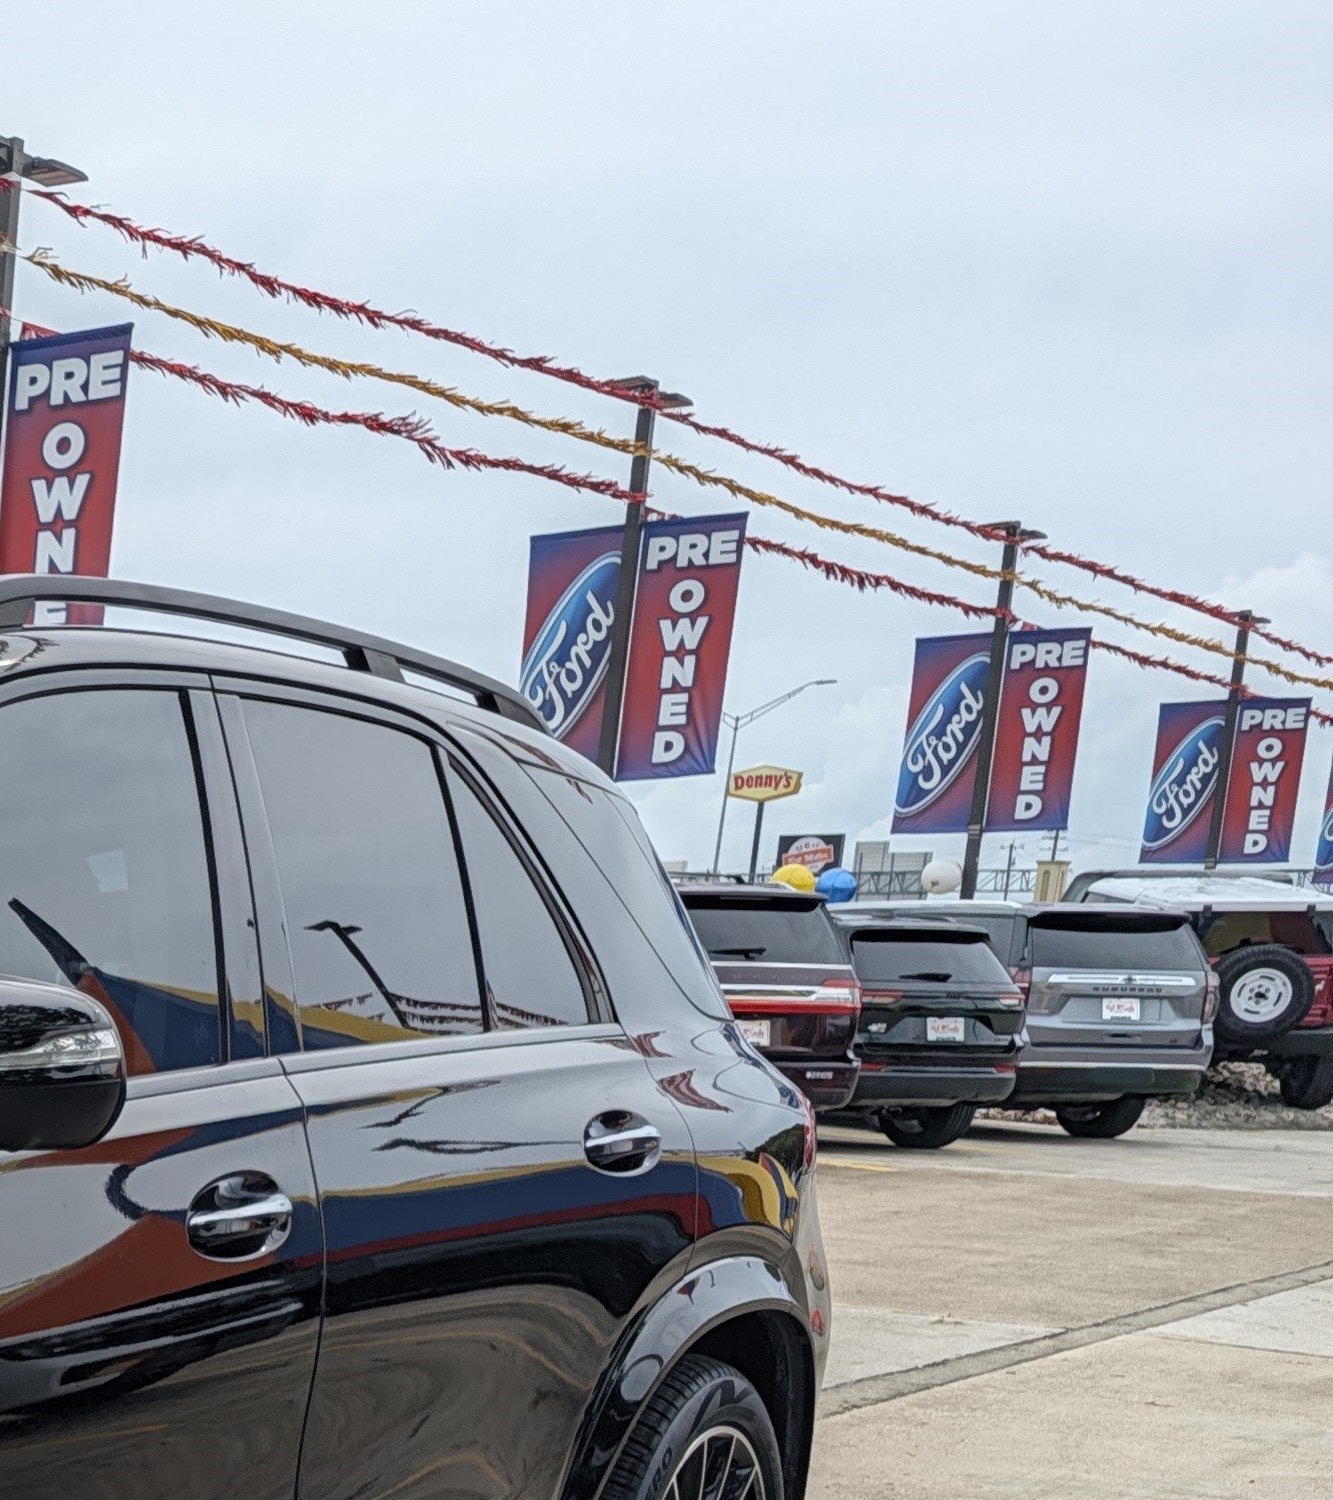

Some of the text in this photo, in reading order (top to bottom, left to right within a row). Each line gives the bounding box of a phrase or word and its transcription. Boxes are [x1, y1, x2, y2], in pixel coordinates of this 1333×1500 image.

[14, 349, 125, 412] PRE
[31, 421, 91, 626] OWNE
[645, 529, 741, 572] PRE
[524, 589, 615, 728] Ford
[651, 578, 710, 765] OWNED
[1009, 639, 1087, 671] PRE
[906, 680, 984, 790] Ford
[1014, 676, 1063, 821] OWNED
[1240, 706, 1308, 732] PRE
[733, 770, 793, 791] Denny's
[1152, 739, 1219, 829] Ford
[1242, 736, 1286, 855] OWNED
